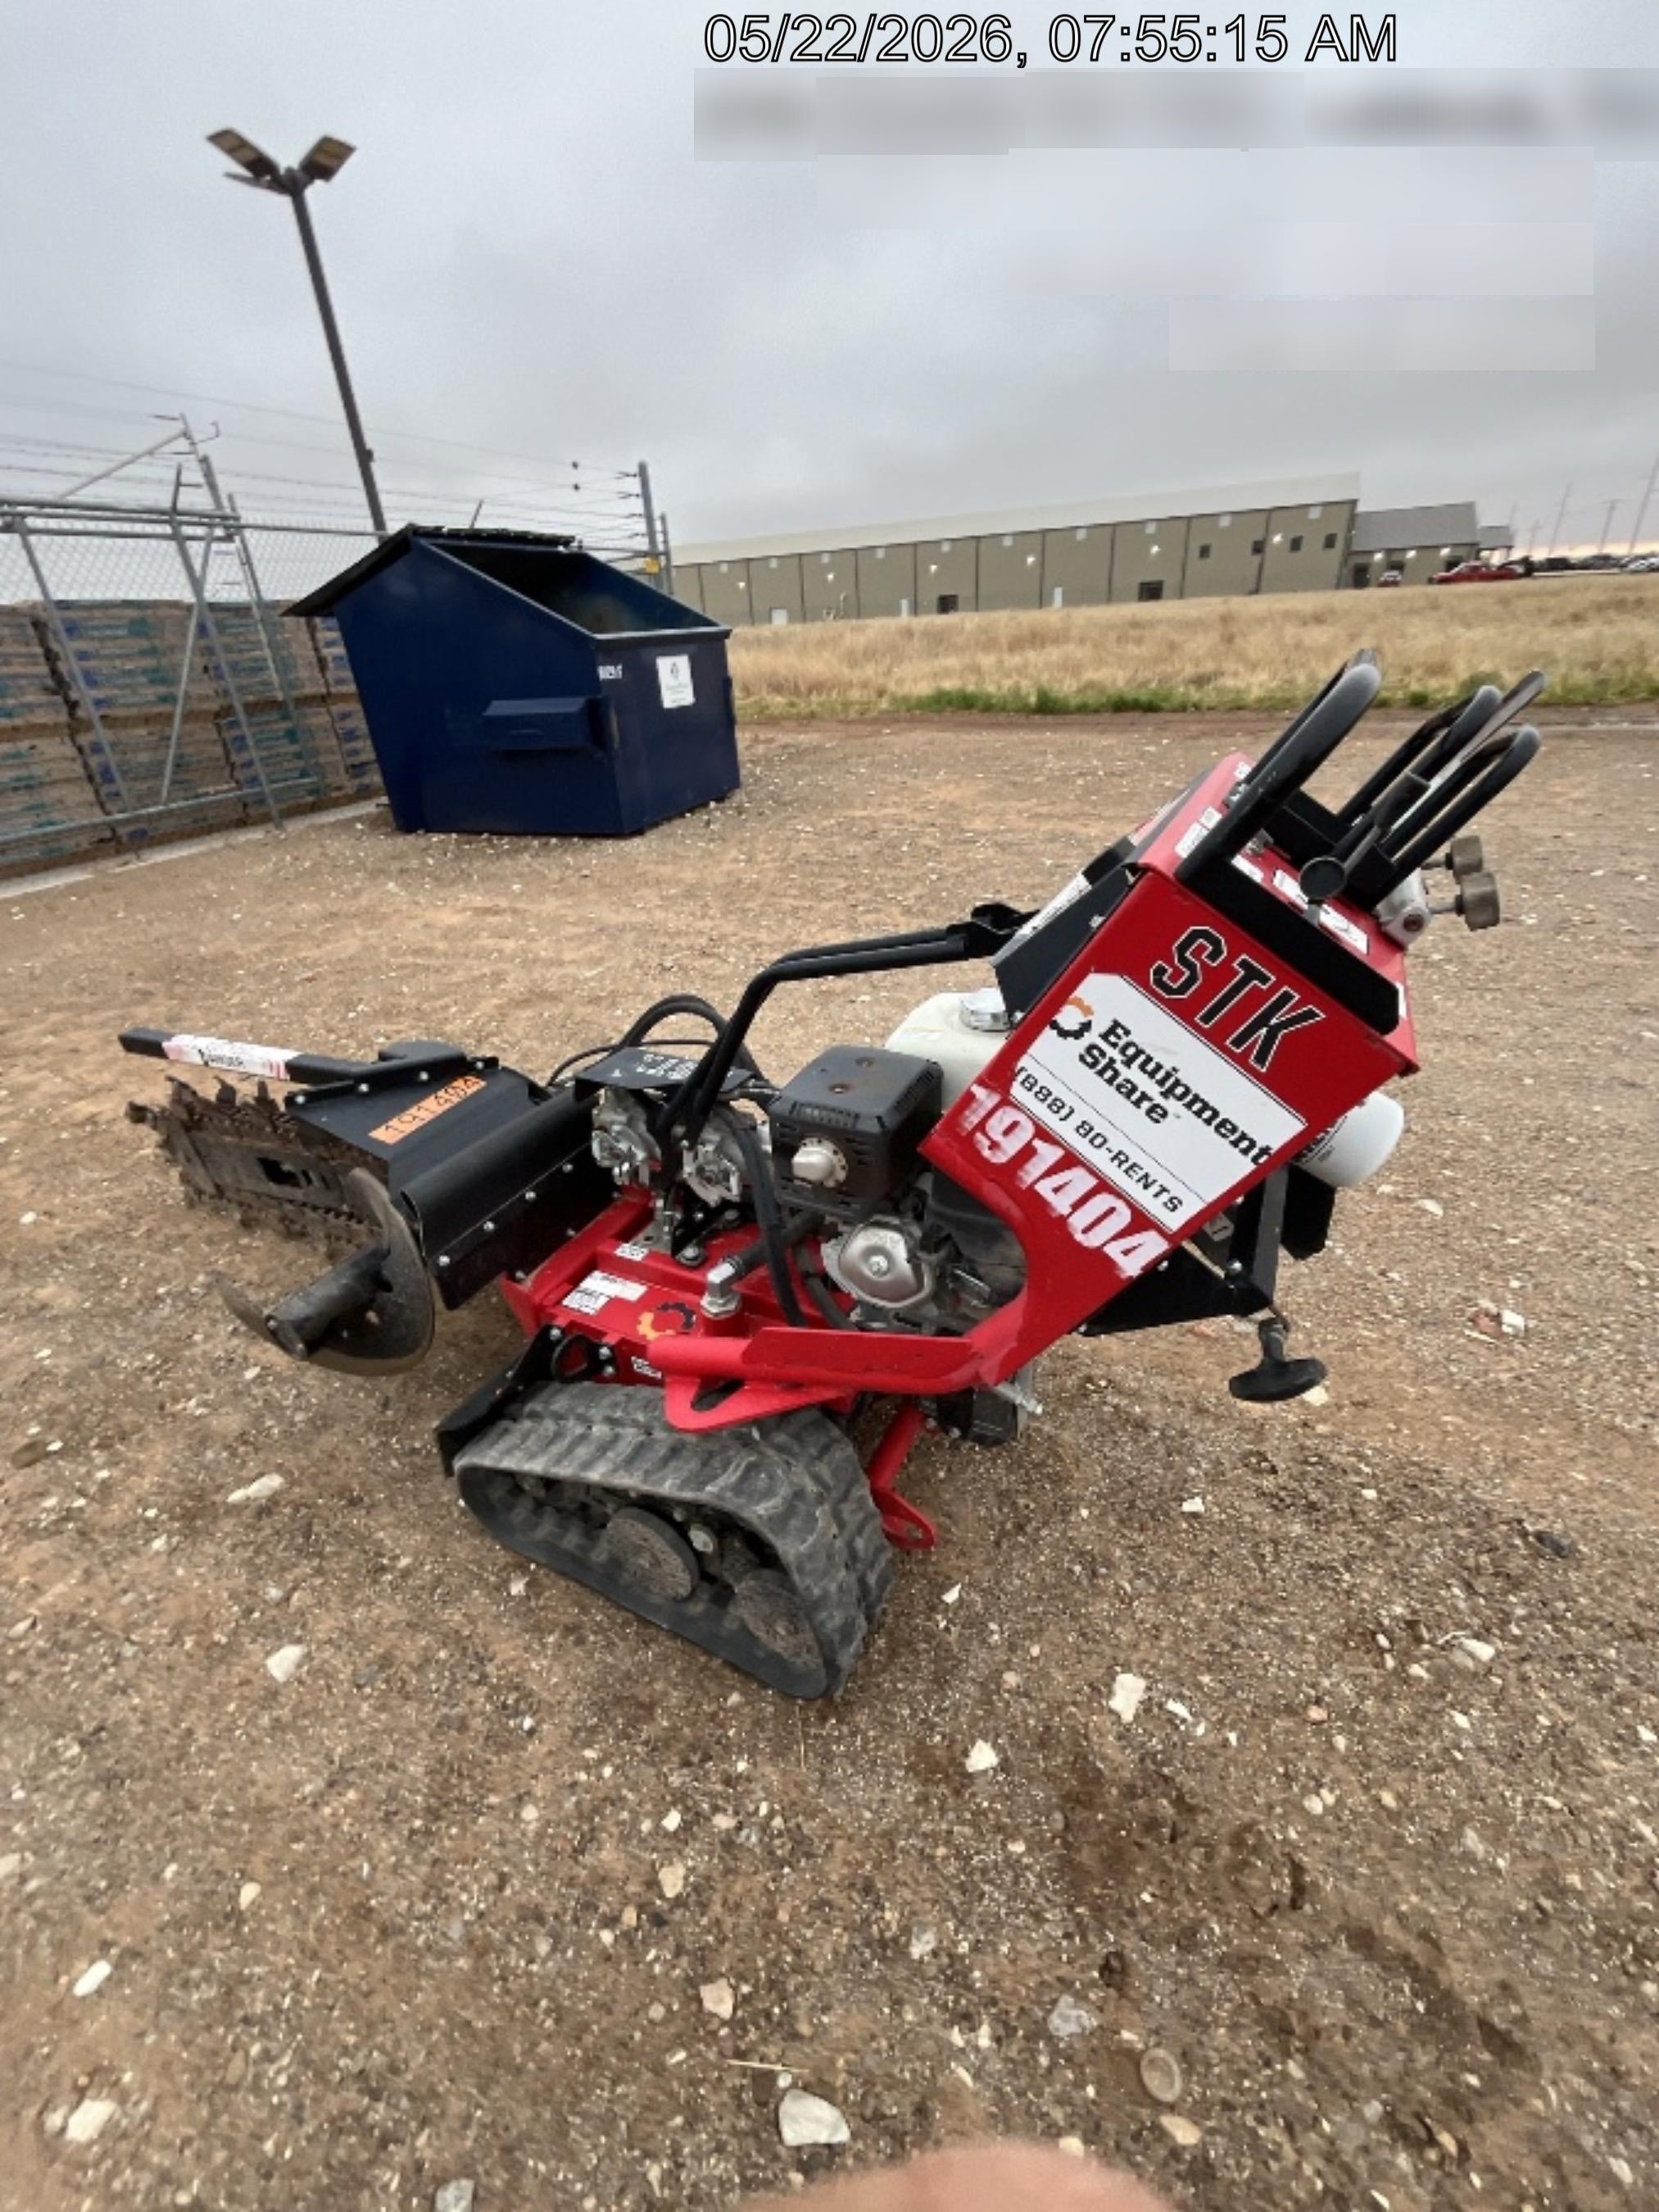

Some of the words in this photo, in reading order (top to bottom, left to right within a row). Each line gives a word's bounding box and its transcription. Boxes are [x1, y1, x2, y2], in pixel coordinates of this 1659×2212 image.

[1150, 926, 1326, 1072] STK
[1015, 1066, 1076, 1121] (888)
[1075, 1120, 1184, 1213] 80-RENTS
[1078, 1044, 1168, 1124] Share
[1099, 1018, 1273, 1166] Equipment
[959, 1083, 1170, 1278] 191404
